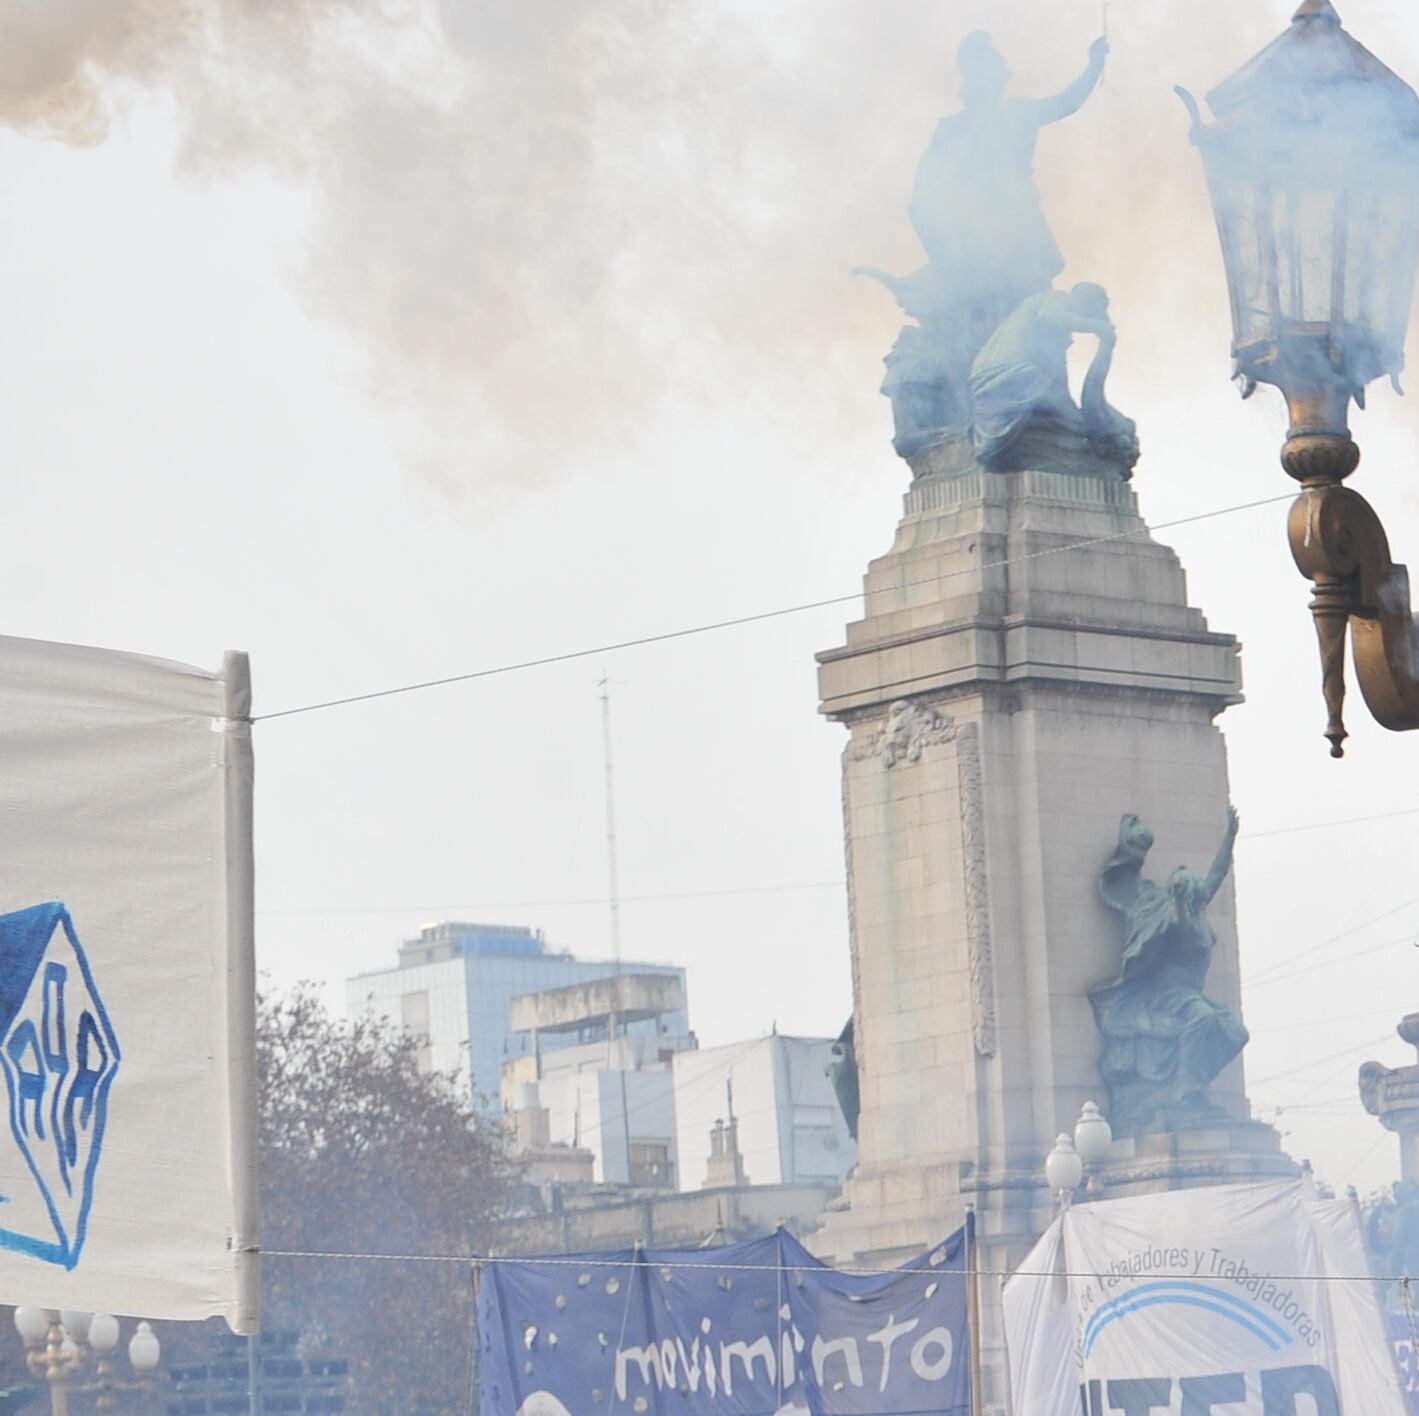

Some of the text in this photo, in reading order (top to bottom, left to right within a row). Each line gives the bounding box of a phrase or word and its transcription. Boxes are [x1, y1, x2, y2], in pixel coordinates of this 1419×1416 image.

[1193, 1249, 1204, 1276] y
[1209, 1247, 1322, 1348] Trabajadoras
[615, 1304, 954, 1402] moviminto
